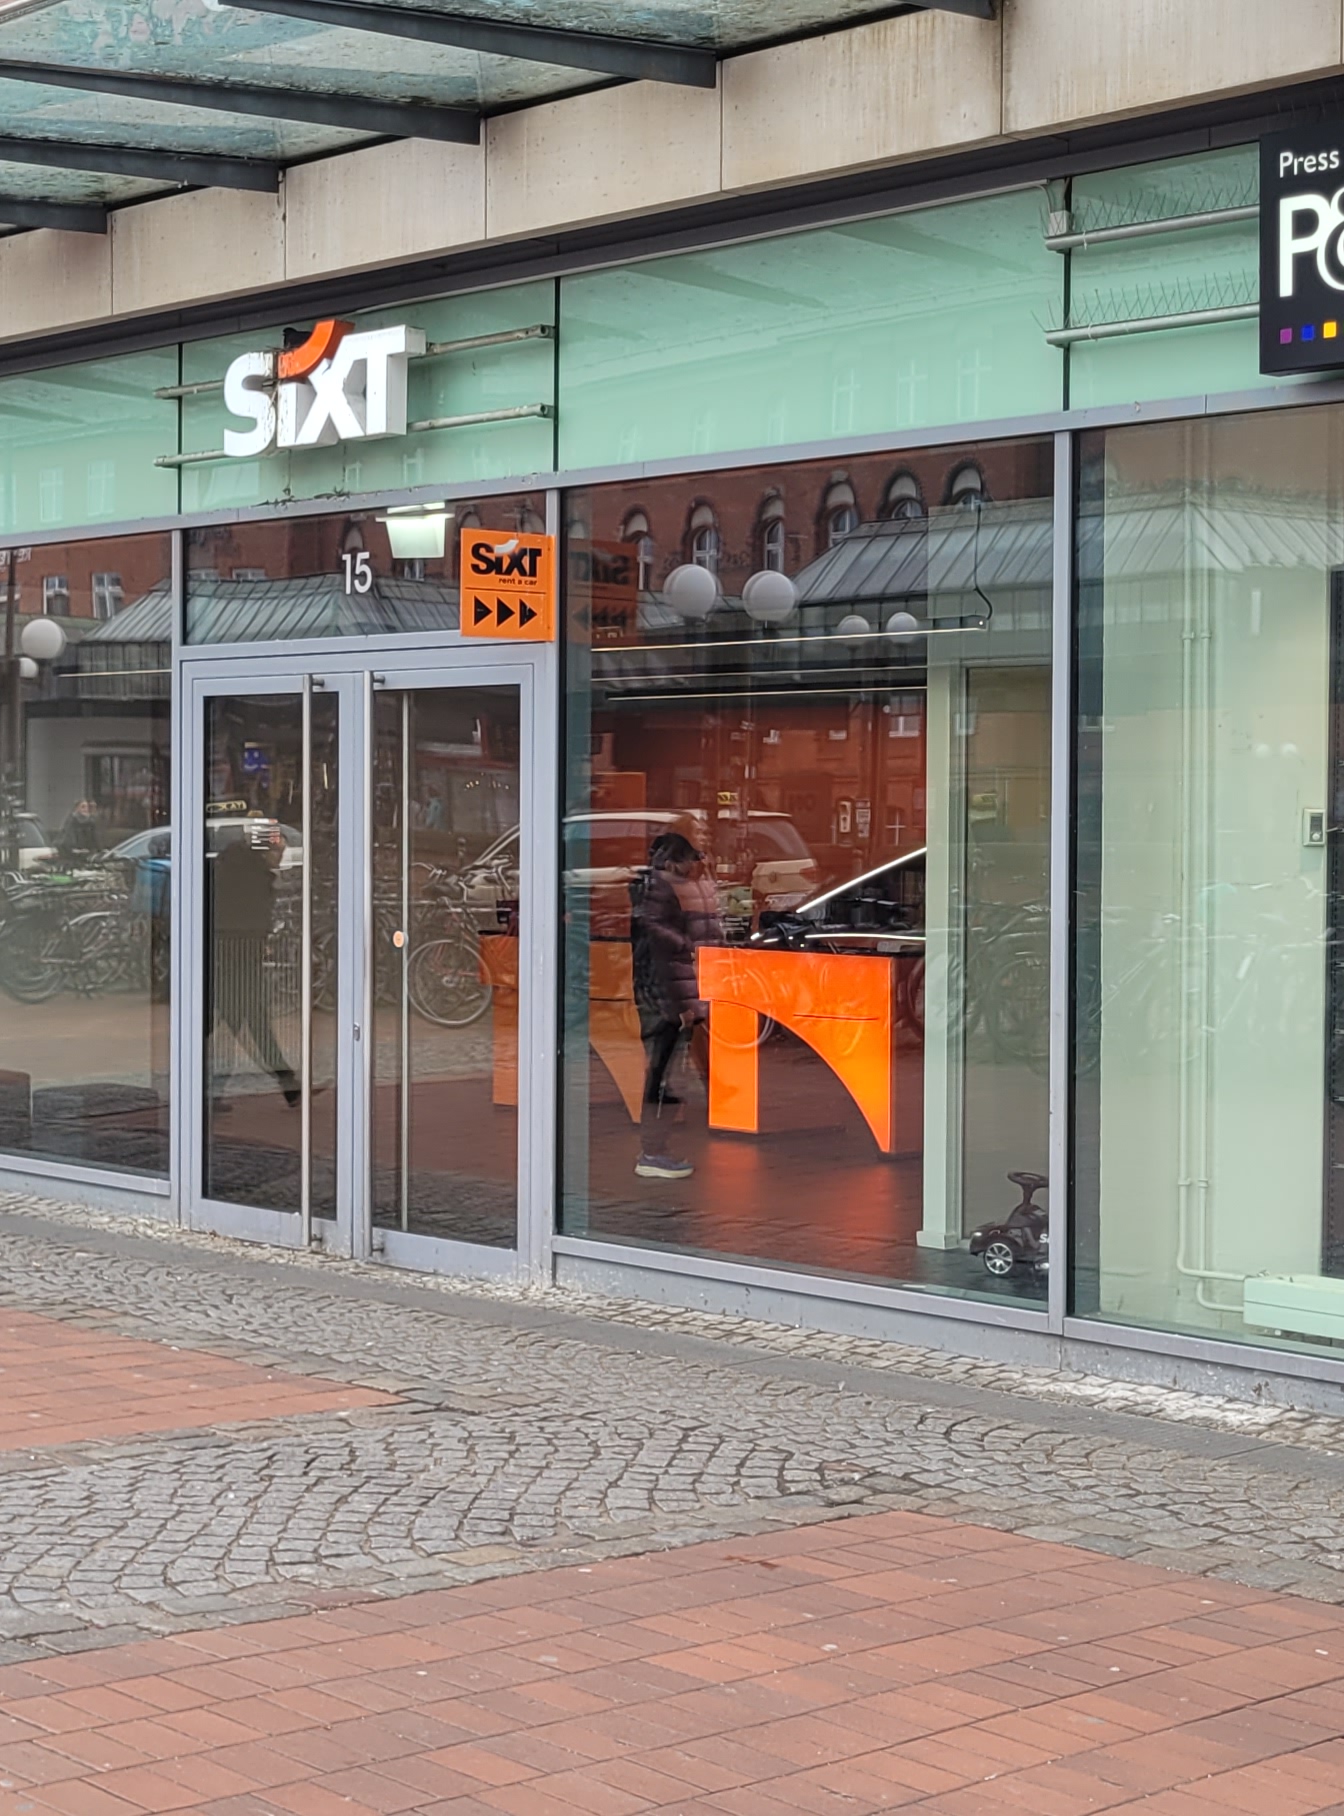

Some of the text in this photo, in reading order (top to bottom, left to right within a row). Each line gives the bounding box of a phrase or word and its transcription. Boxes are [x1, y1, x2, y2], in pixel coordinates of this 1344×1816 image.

[1279, 150, 1340, 178] Press
[341, 551, 373, 595] 15
[498, 577, 516, 585] rent
